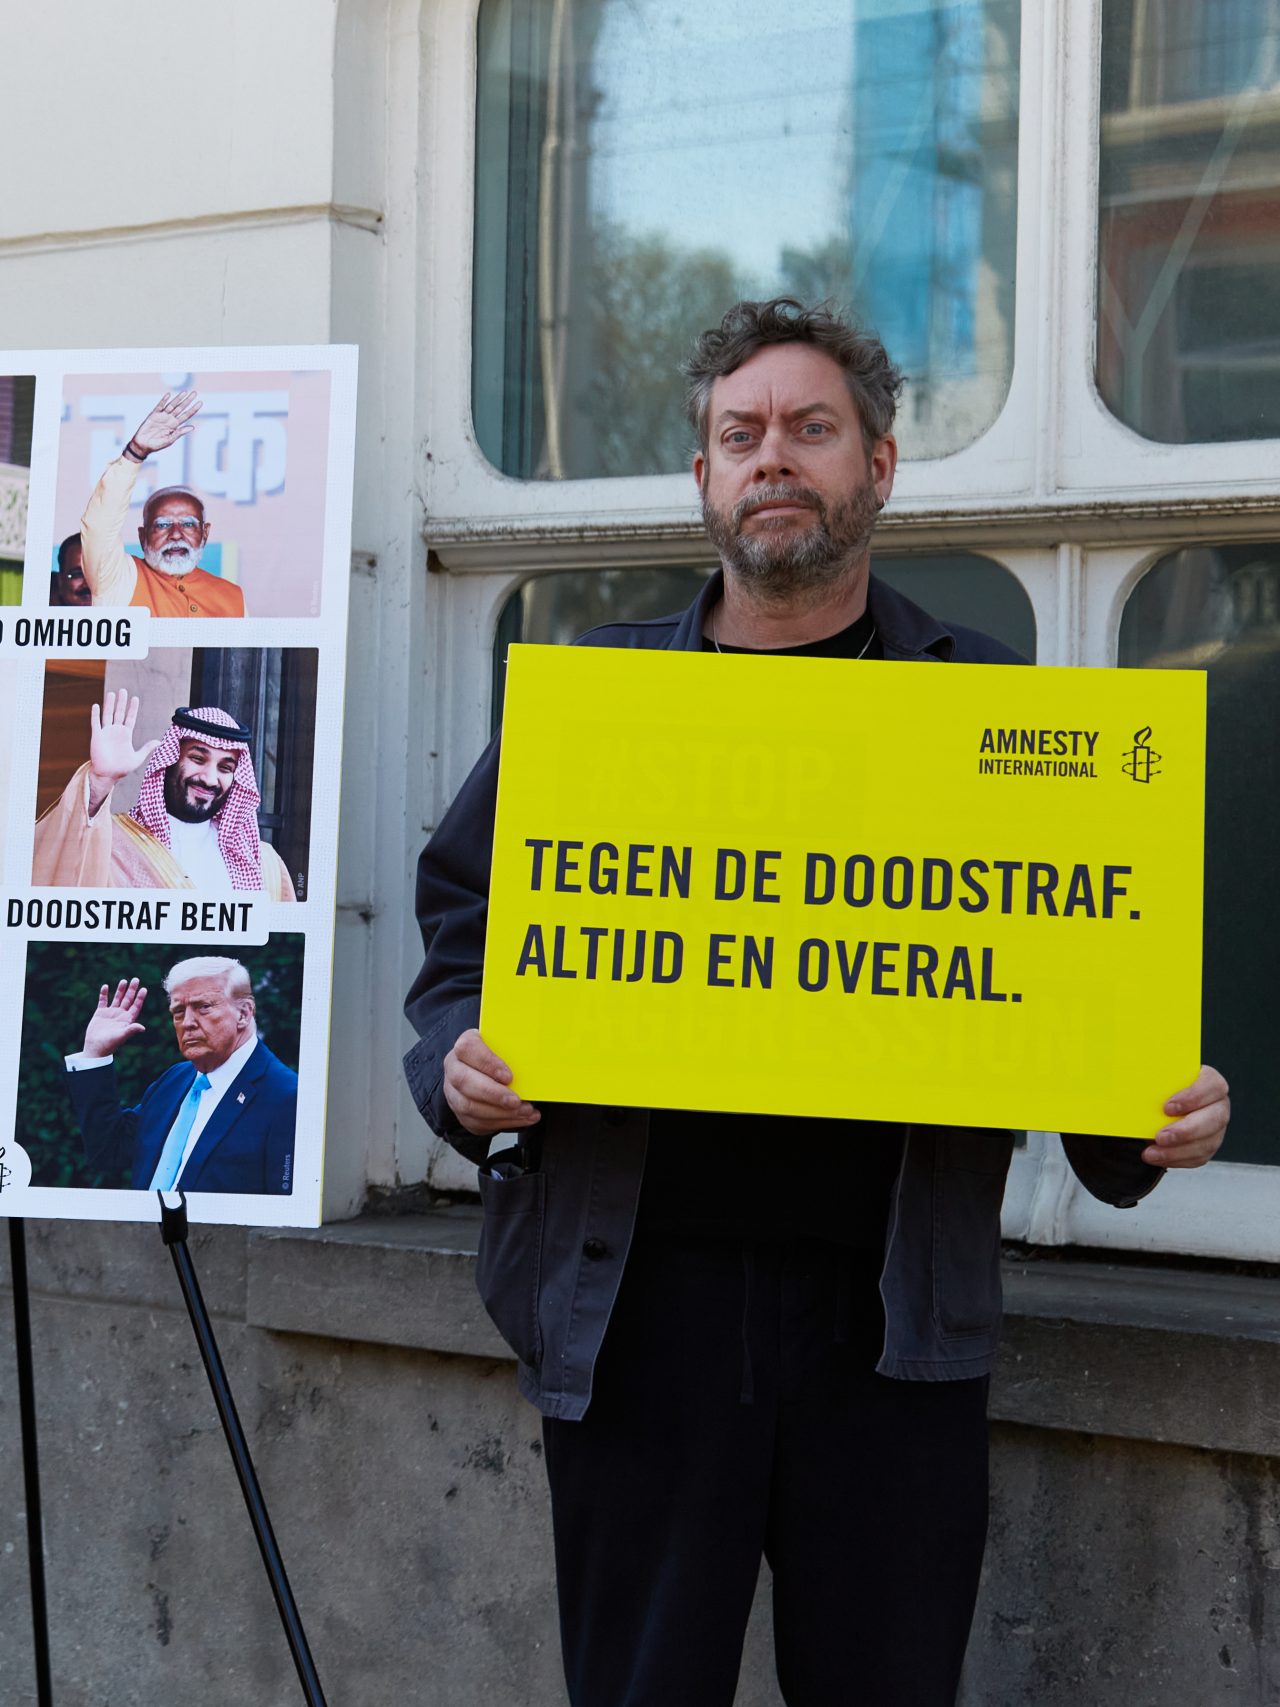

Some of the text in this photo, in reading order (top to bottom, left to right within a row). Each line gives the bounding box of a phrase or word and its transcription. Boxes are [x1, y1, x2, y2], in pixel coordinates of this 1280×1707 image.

[14, 618, 131, 647] OMHOOG
[980, 728, 1100, 757] AMNESTY
[978, 758, 1098, 778] INTERNATIONAL
[297, 872, 305, 888] ANP
[524, 838, 692, 899] TEGEN
[714, 848, 782, 904] DE
[804, 852, 1141, 920] DOODSTRAF.
[6, 898, 171, 931] DOODSTRAF
[181, 902, 253, 932] BENT
[516, 923, 1022, 1003] ALTIJD EN OVERAL.
[282, 1154, 291, 1181] Reuters
